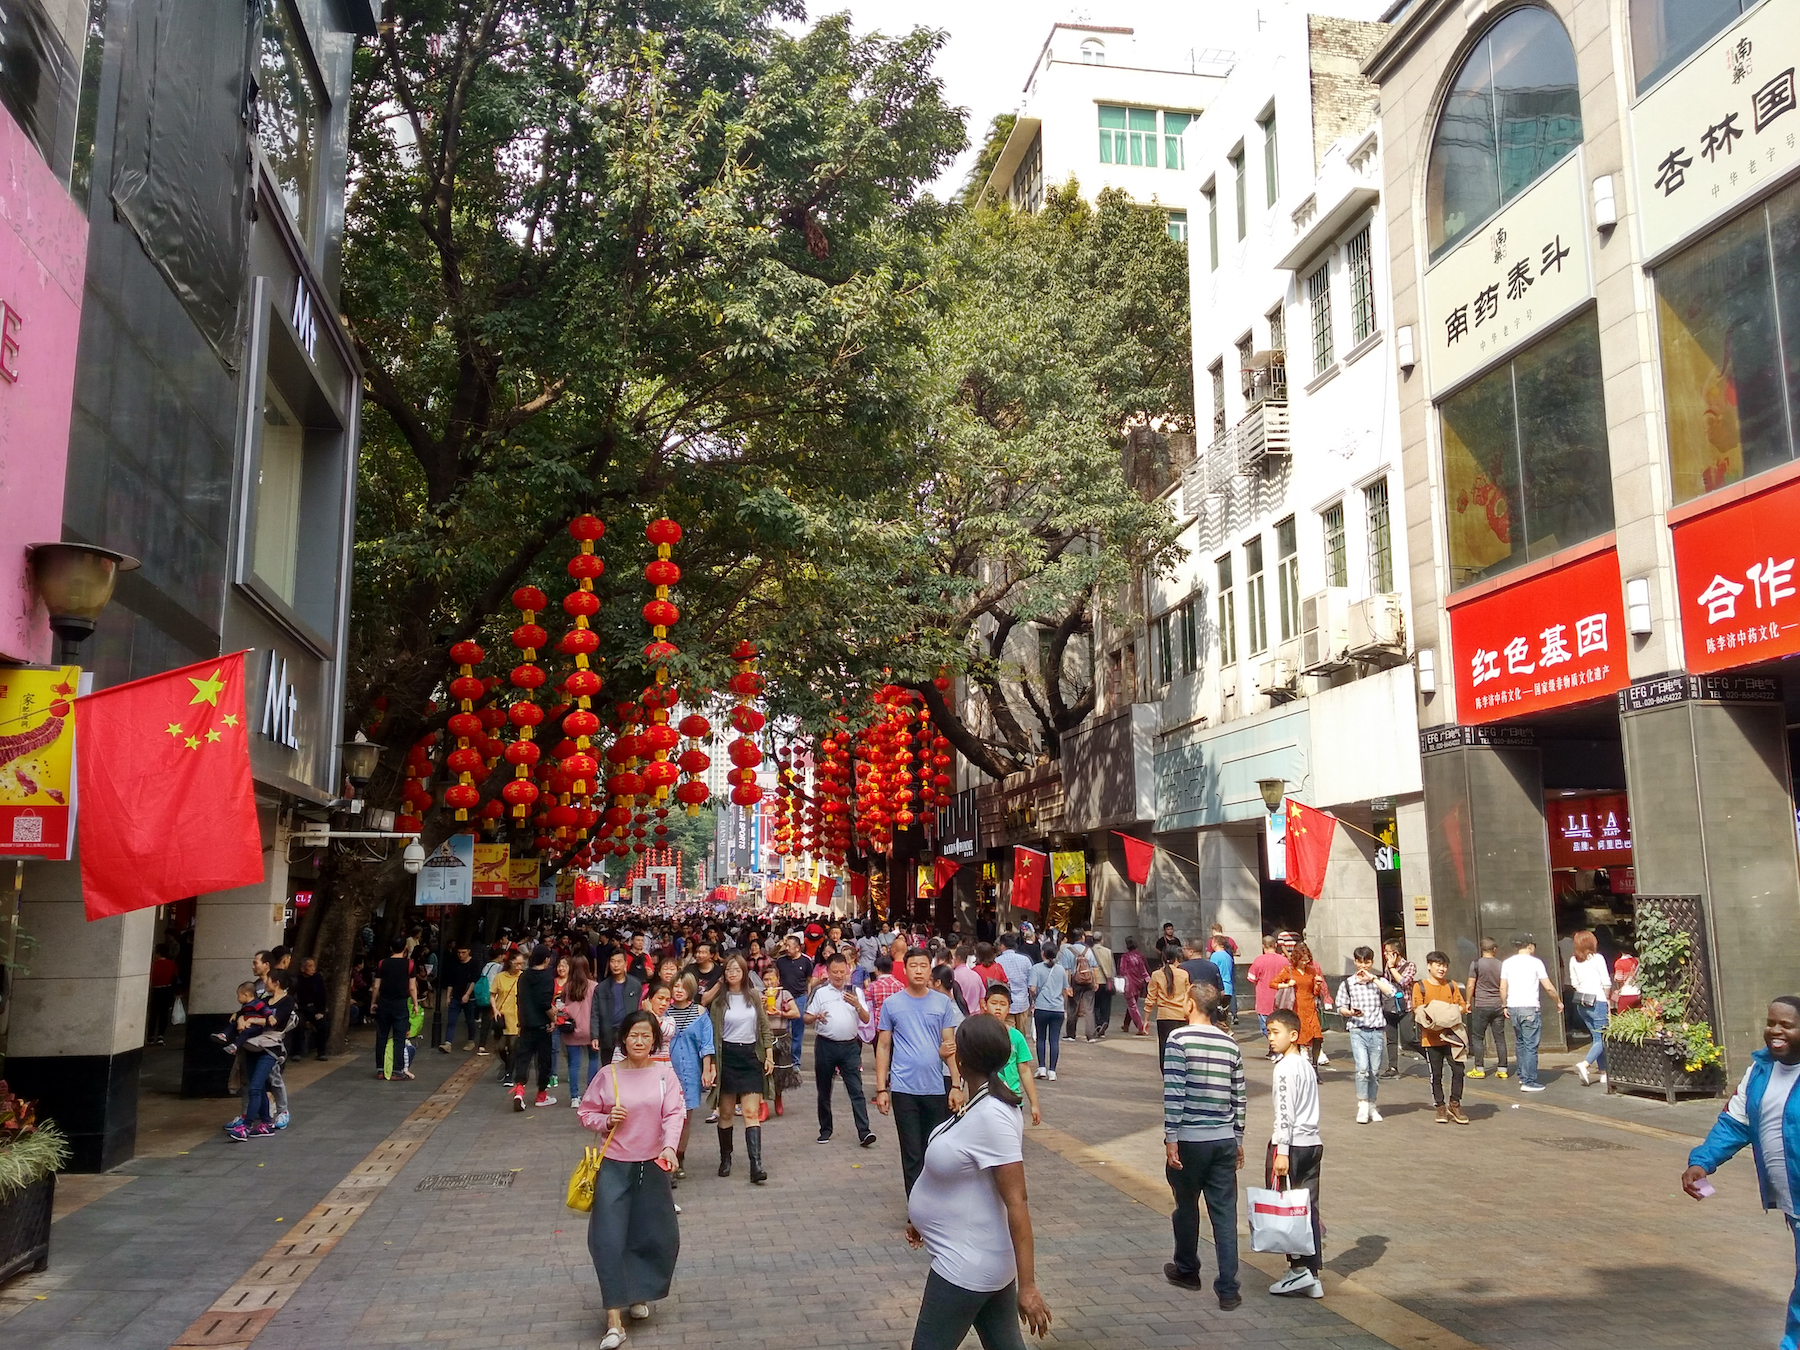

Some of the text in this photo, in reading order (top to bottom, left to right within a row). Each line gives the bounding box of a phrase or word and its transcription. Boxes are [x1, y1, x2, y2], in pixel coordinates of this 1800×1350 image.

[1654, 67, 1797, 198] 杏林国
[1711, 133, 1796, 198] 中华老字号
[1445, 234, 1571, 348] 南药泰斗
[1697, 557, 1797, 625] 合作
[1471, 611, 1609, 688] 红色基因
[1630, 679, 1684, 700] EFG 广日电气
[1707, 677, 1777, 690] EFG 广日电气
[1428, 733, 1439, 745] EFG
[1478, 728, 1535, 738] EFG 广日电气
